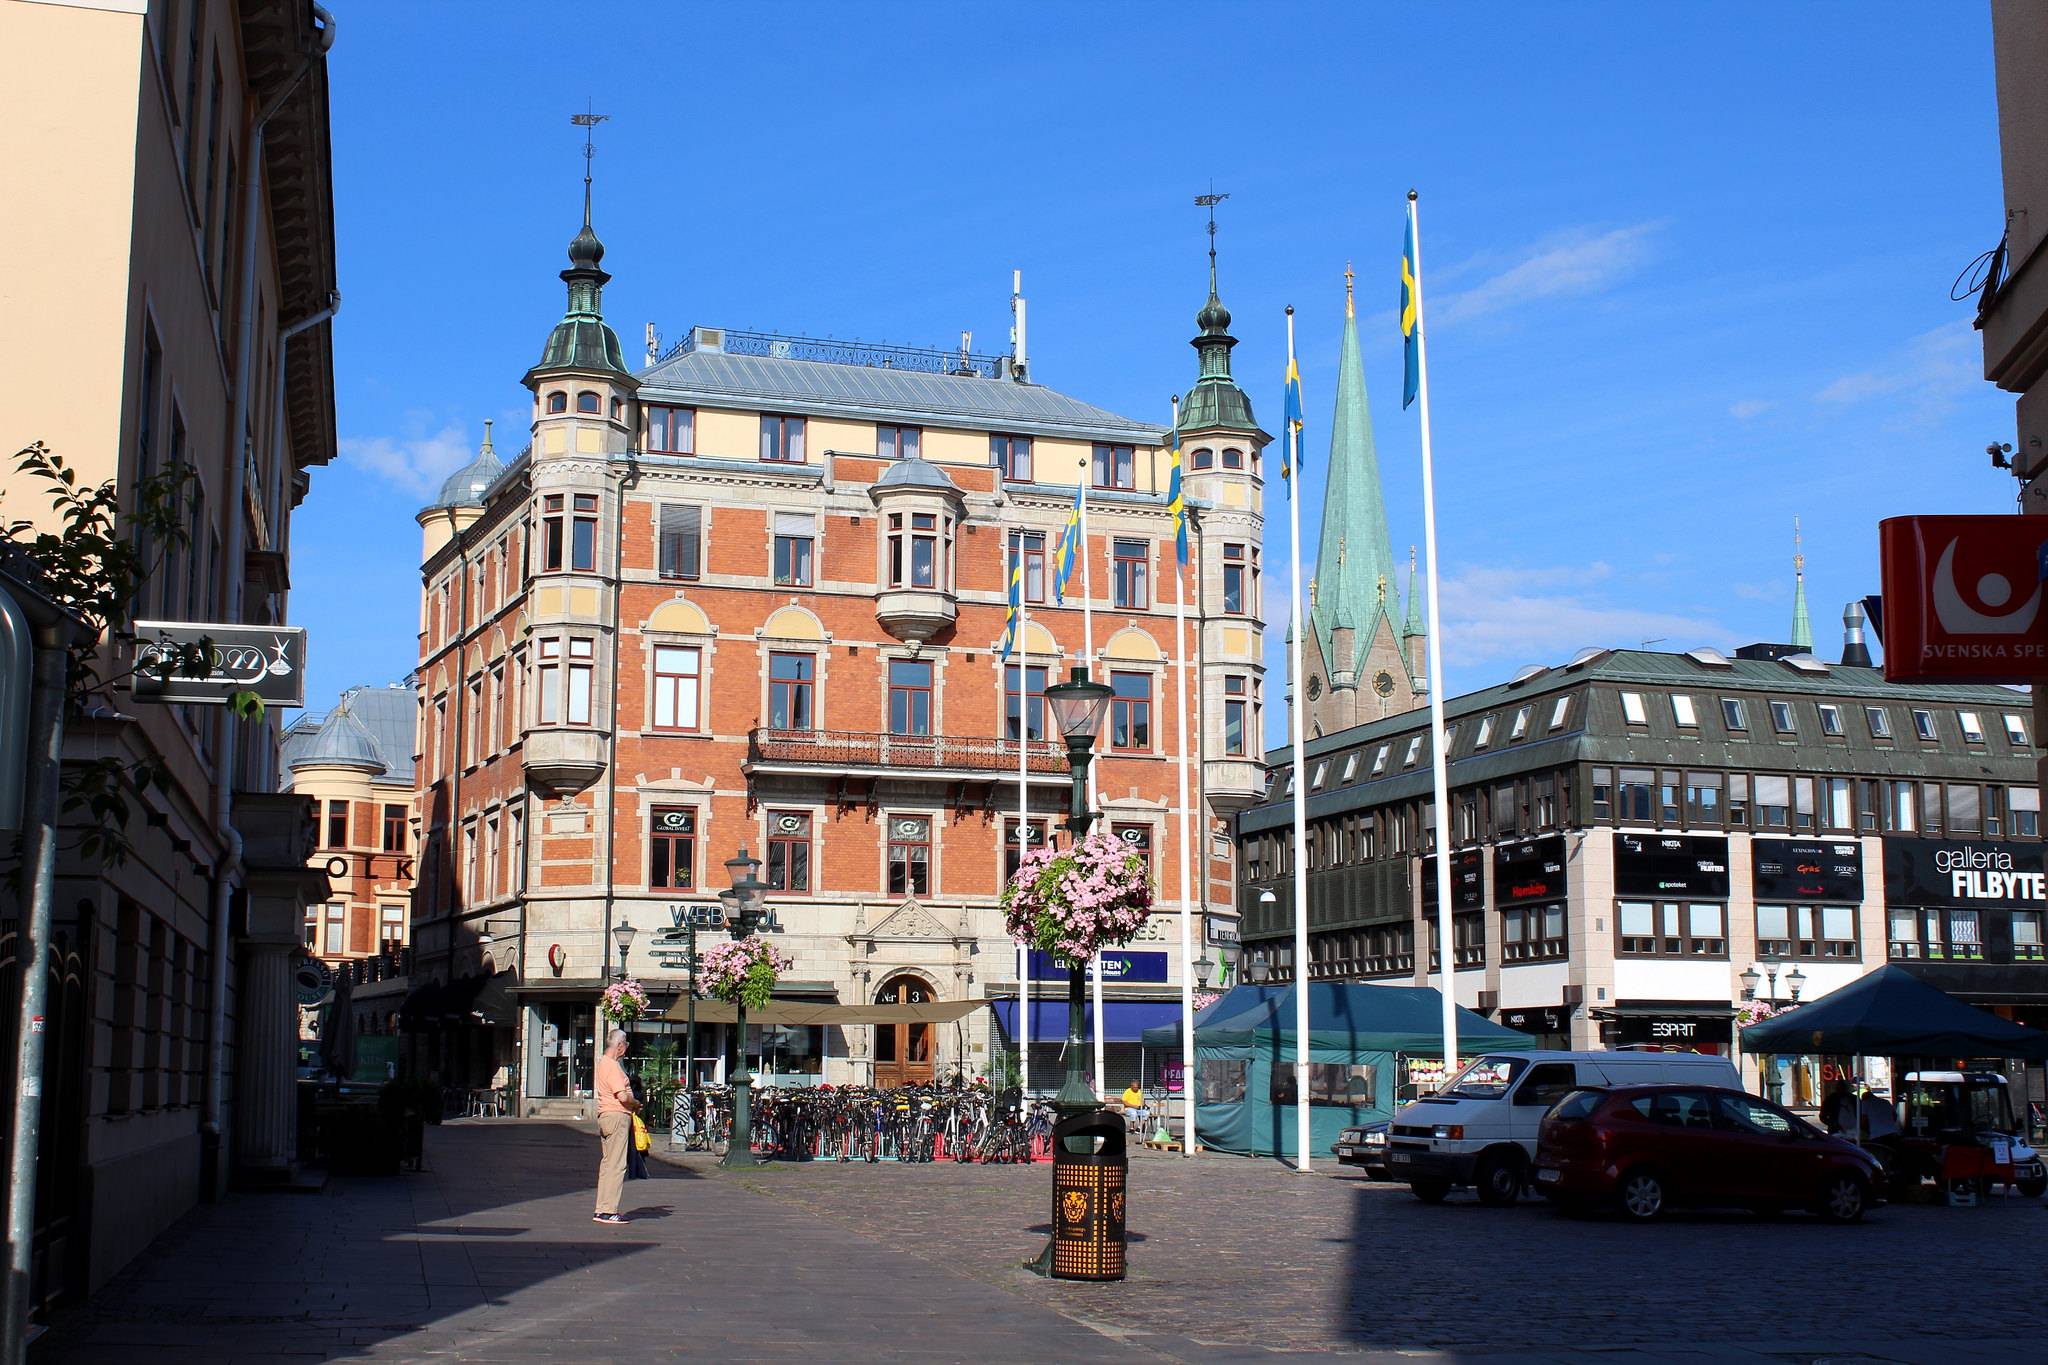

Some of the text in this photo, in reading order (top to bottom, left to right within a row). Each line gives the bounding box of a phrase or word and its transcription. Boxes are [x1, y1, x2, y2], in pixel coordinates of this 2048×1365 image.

[226, 649, 259, 670] 22
[1923, 644, 2046, 658] SVENSKA SPE
[1935, 846, 2013, 873] galleria
[1952, 870, 2046, 899] FILBYTE
[881, 991, 920, 1002] Nr 3
[1652, 1023, 1697, 1037] ESPRIT
